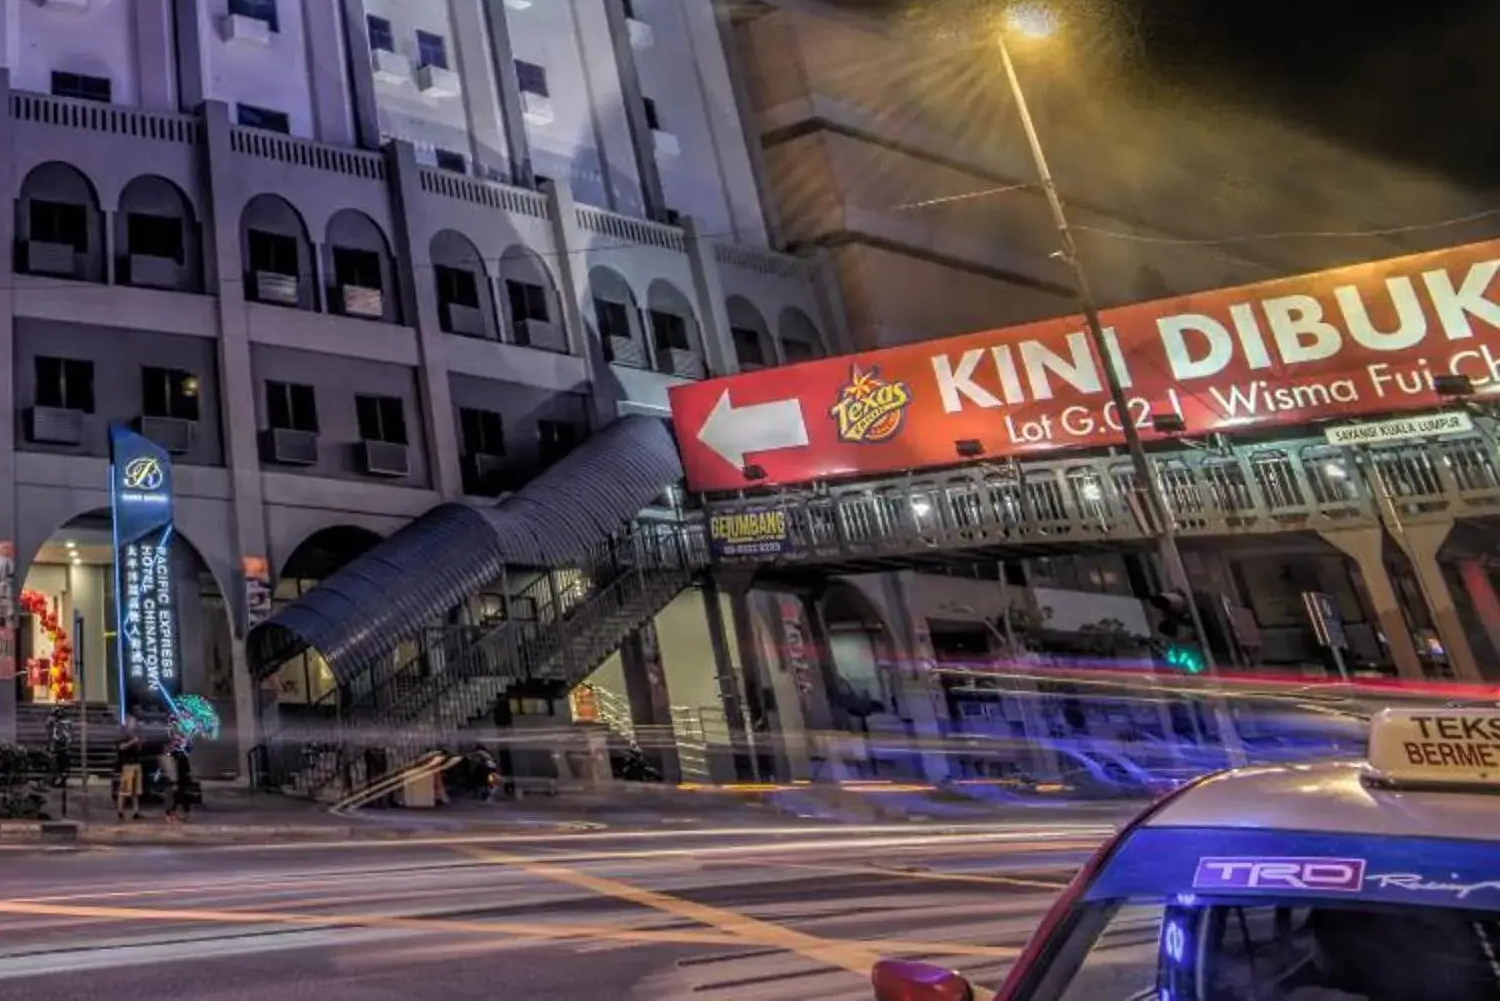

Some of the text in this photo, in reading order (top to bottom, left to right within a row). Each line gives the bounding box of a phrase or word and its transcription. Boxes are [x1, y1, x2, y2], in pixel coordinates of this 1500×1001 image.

[931, 326, 1133, 415] KINI
[1208, 378, 1359, 420] Wisma
[1367, 358, 1436, 398] Fui
[831, 382, 907, 436] Texas
[1004, 413, 1051, 444] Lot
[1380, 421, 1415, 437] KUALA
[1419, 416, 1461, 431] LUMPUR
[141, 545, 159, 691] HOTEL CHINATOWN
[155, 546, 174, 679] PACIFIC EXPRESS
[1205, 862, 1352, 888] TRD
